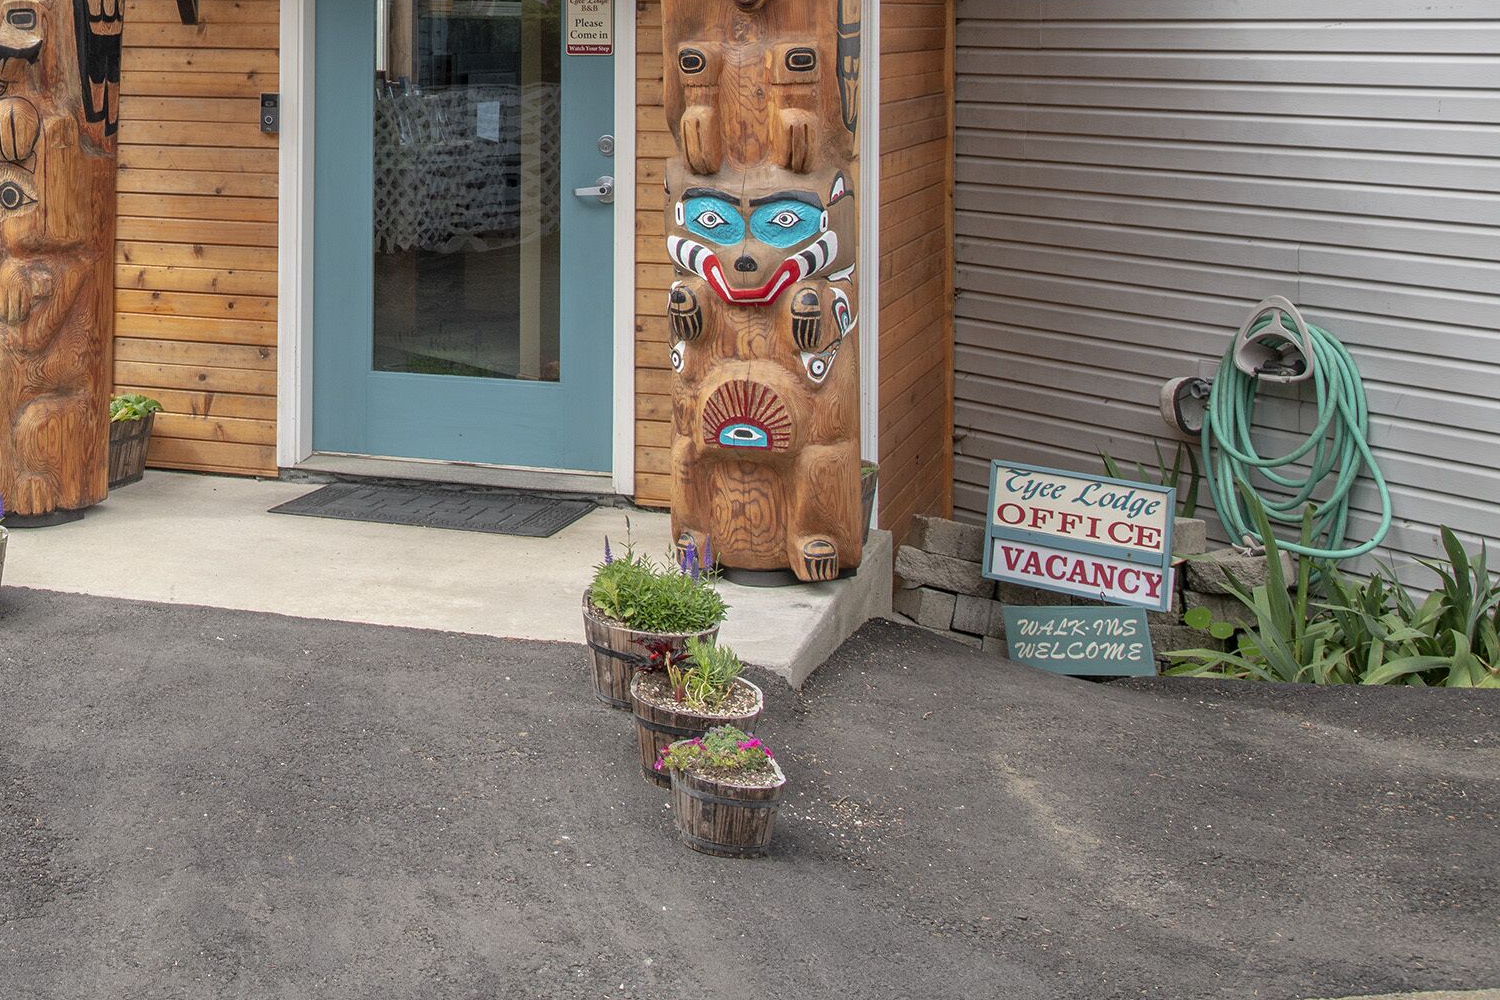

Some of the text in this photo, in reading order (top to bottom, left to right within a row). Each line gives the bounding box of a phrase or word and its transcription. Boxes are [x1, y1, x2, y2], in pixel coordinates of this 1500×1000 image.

[570, 30, 608, 39] Come in
[575, 18, 604, 28] Please
[1005, 469, 1161, 519] Tyee Lodge
[997, 503, 1162, 550] OFFICE
[1001, 546, 1163, 599] VACANCY
[1014, 642, 1144, 661] WELCOME
